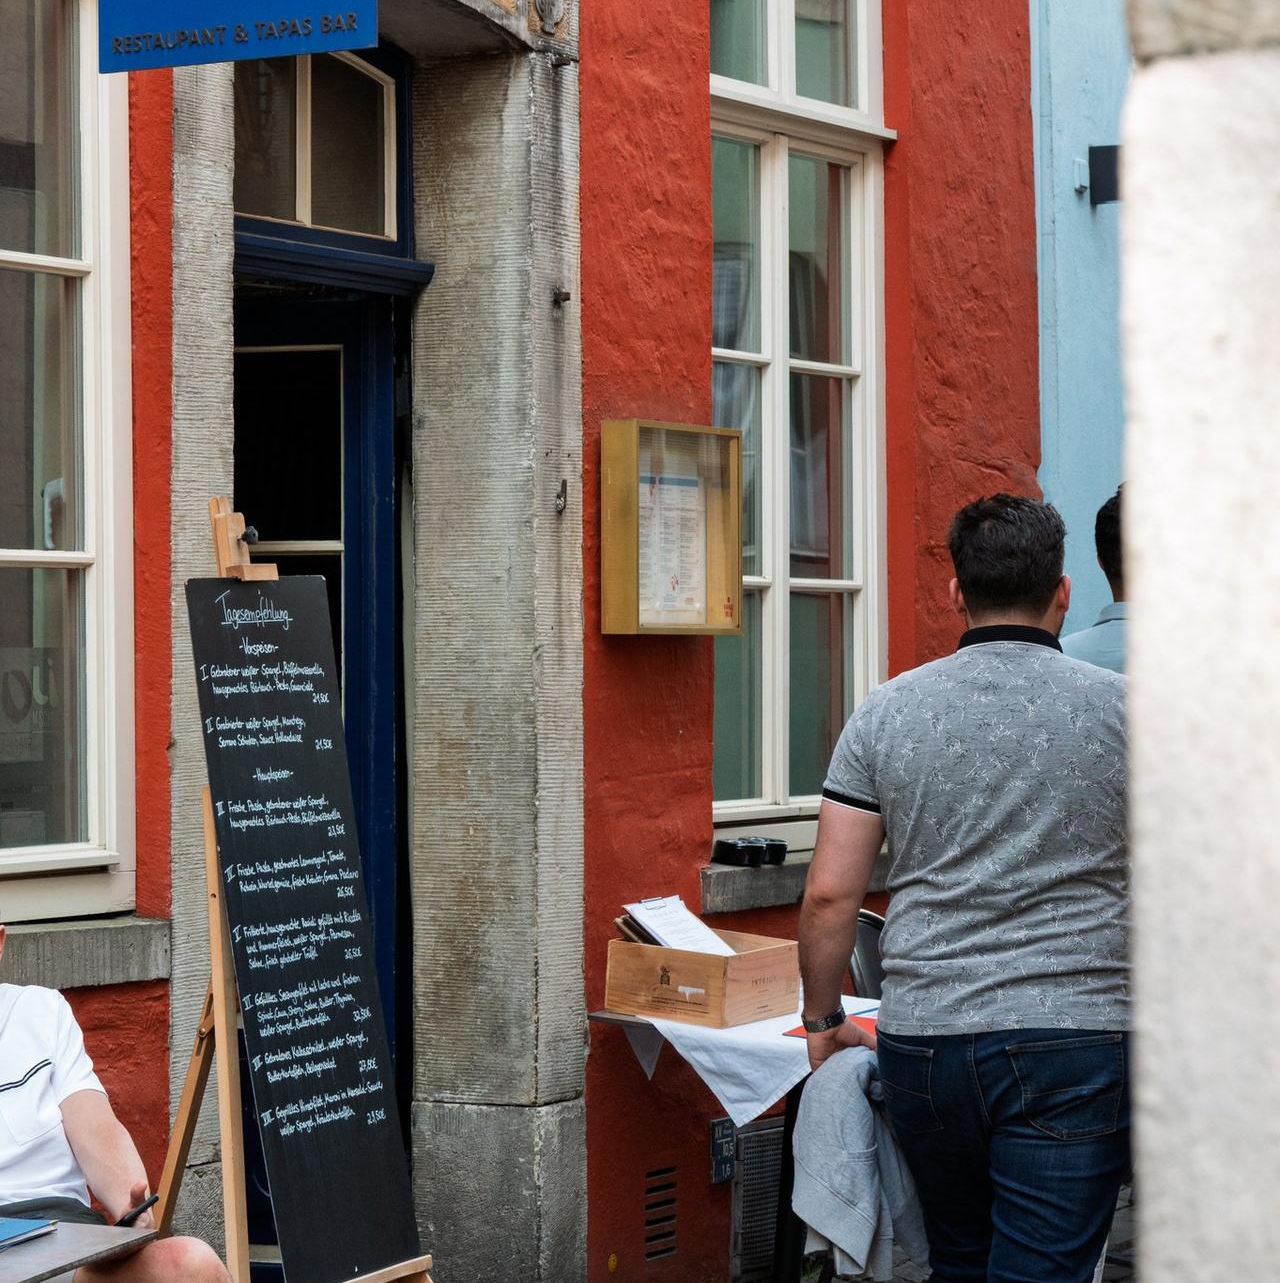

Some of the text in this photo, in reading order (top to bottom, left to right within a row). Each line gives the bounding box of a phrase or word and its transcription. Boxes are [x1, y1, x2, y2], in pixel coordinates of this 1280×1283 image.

[233, 23, 249, 44] &
[255, 17, 312, 41] TAPAS
[321, 12, 358, 34] BAR
[215, 590, 289, 630] Tagesempfehlung
